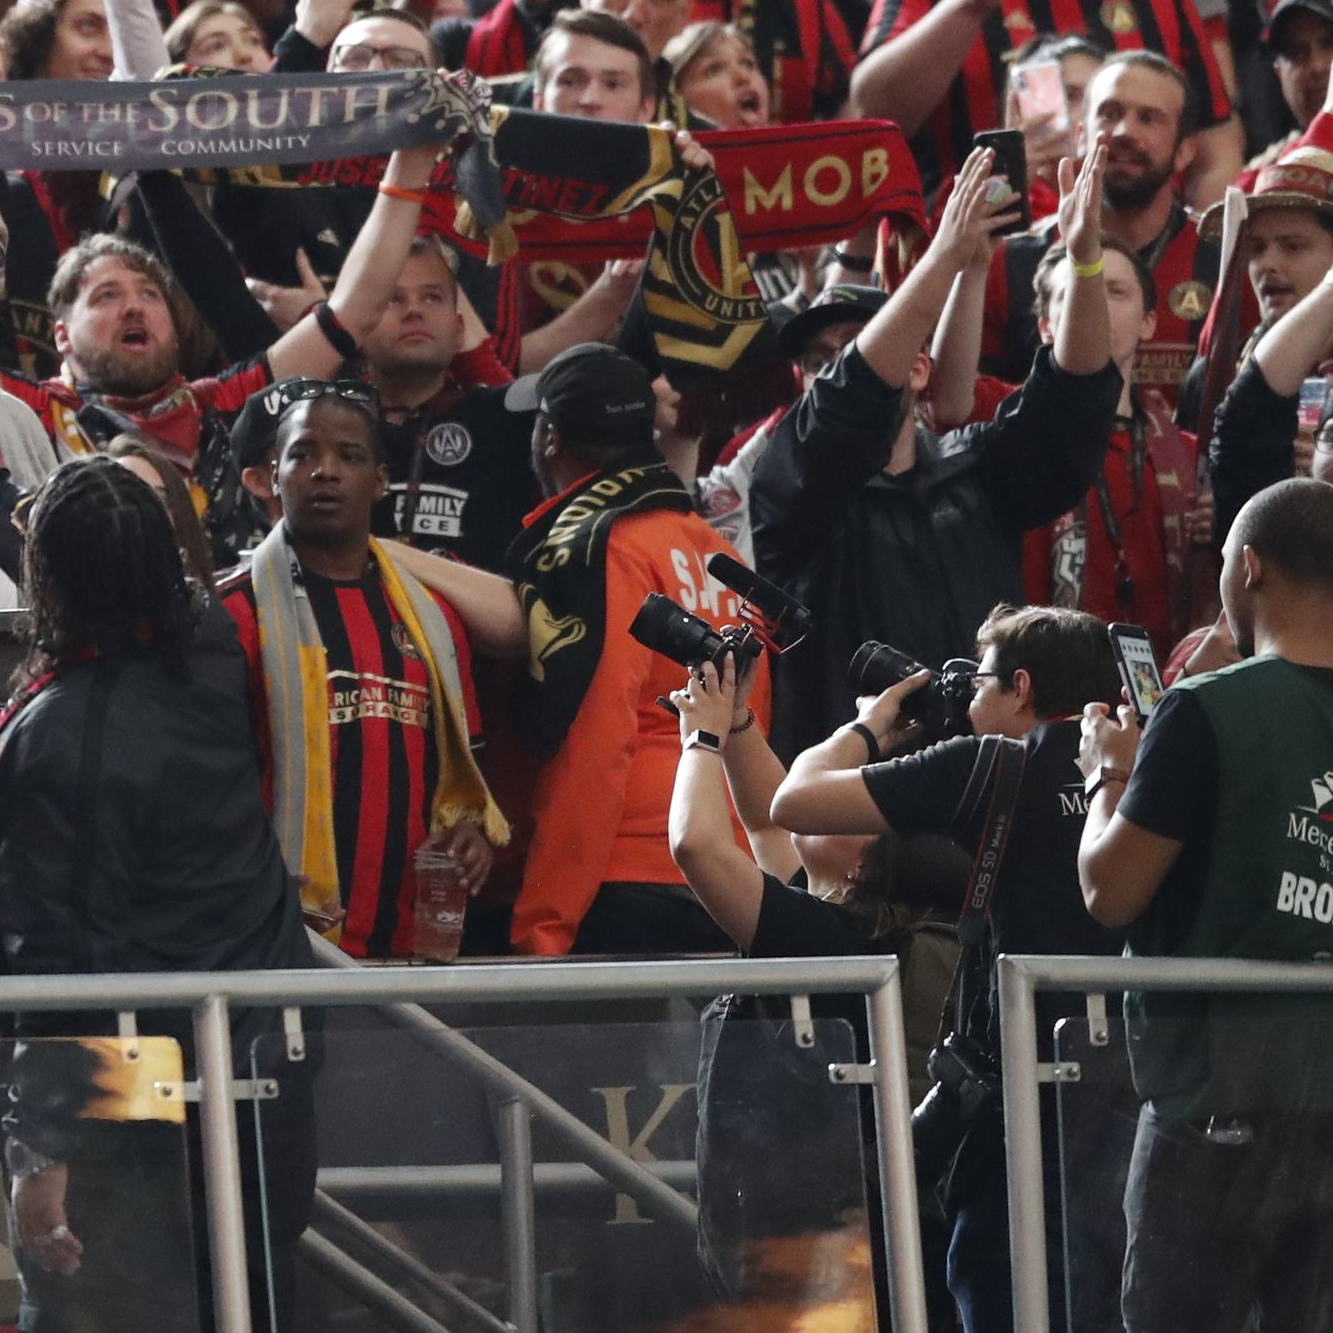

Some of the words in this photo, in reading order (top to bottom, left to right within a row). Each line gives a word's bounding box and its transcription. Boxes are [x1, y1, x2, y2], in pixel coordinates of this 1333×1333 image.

[24, 101, 70, 125] OF
[74, 101, 141, 125] THE
[147, 83, 395, 133] SOUTH
[31, 140, 124, 157] SERVICE
[160, 134, 312, 156] COMMUNITY
[743, 147, 890, 216] MOB
[981, 851, 997, 870] 5D
[972, 873, 992, 909] EOS
